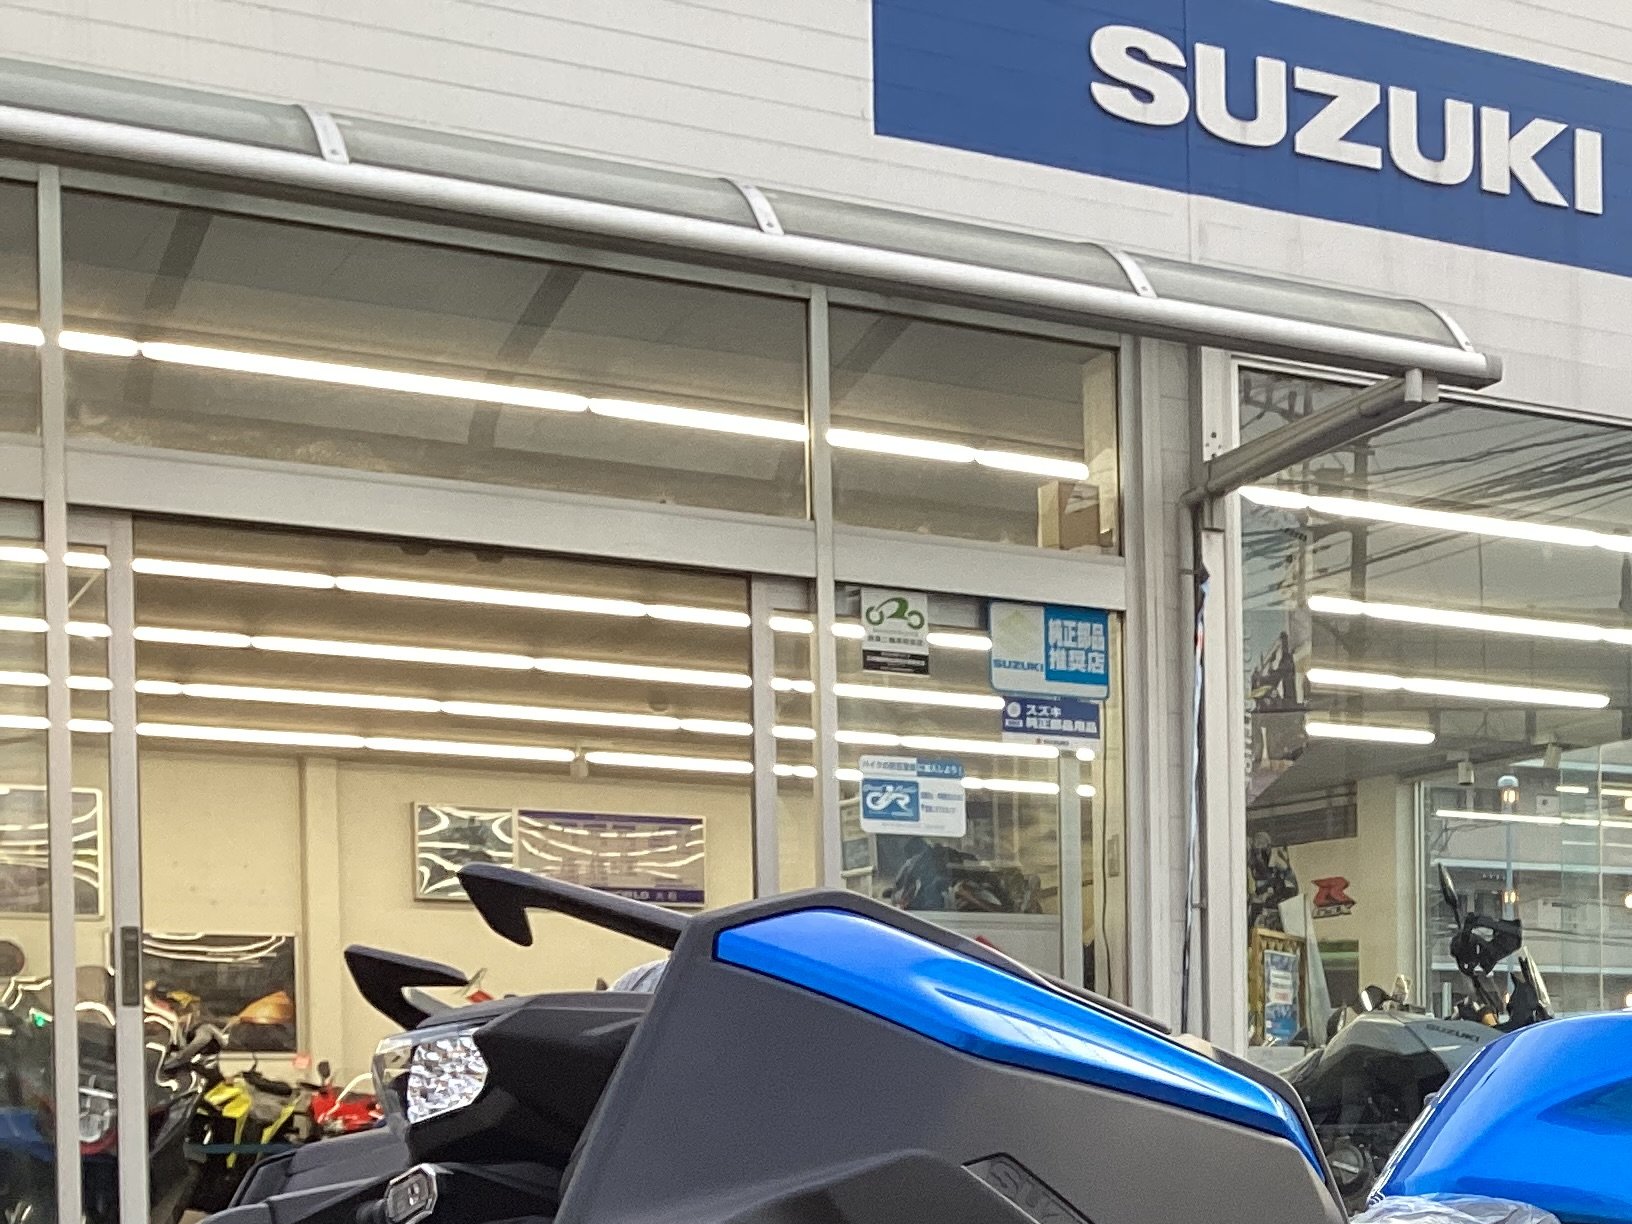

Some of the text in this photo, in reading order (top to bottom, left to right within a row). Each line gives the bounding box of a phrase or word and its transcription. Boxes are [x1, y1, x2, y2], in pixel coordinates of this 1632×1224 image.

[1089, 23, 1605, 215] SUZUKI
[993, 658, 1044, 673] SUZUKI
[1026, 703, 1062, 718] スズキ
